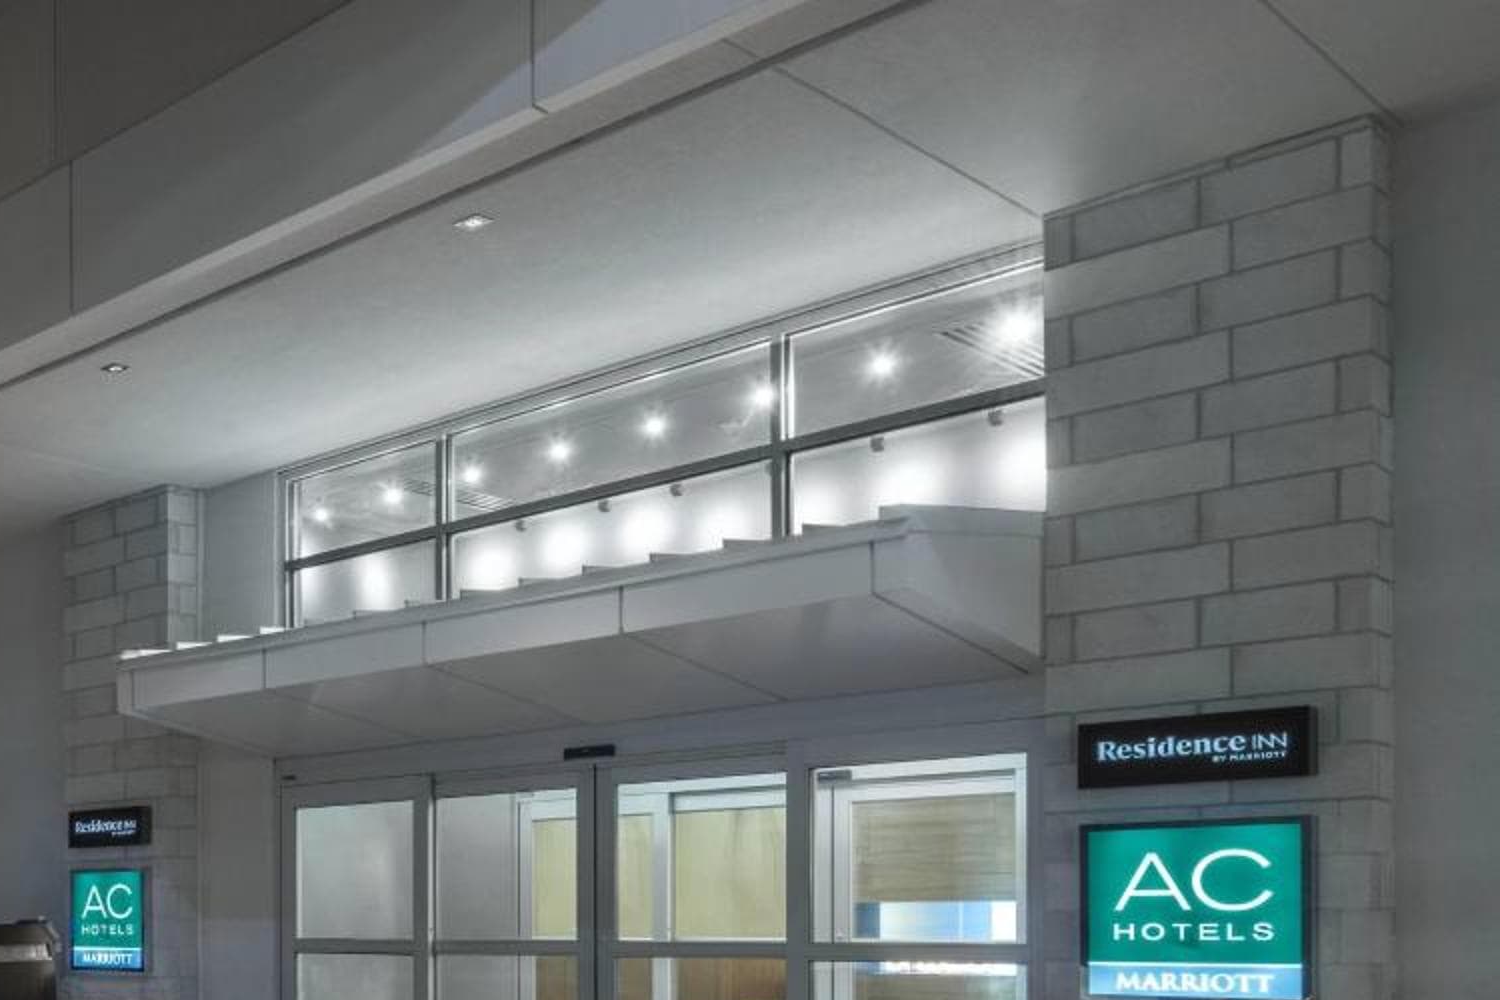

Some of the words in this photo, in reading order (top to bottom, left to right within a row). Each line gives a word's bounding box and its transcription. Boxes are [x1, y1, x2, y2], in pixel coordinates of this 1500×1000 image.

[1097, 734, 1246, 762] Residence
[1251, 732, 1288, 750] INN
[1212, 754, 1226, 763] BY
[1229, 751, 1287, 762] MARRIOTT
[1113, 848, 1274, 912] AC
[81, 883, 133, 919] AC
[81, 923, 134, 936] HOTELS
[1113, 921, 1275, 942] HOTELS
[83, 951, 133, 965] MARRIOTT
[1116, 972, 1275, 993] MARRIOTT
